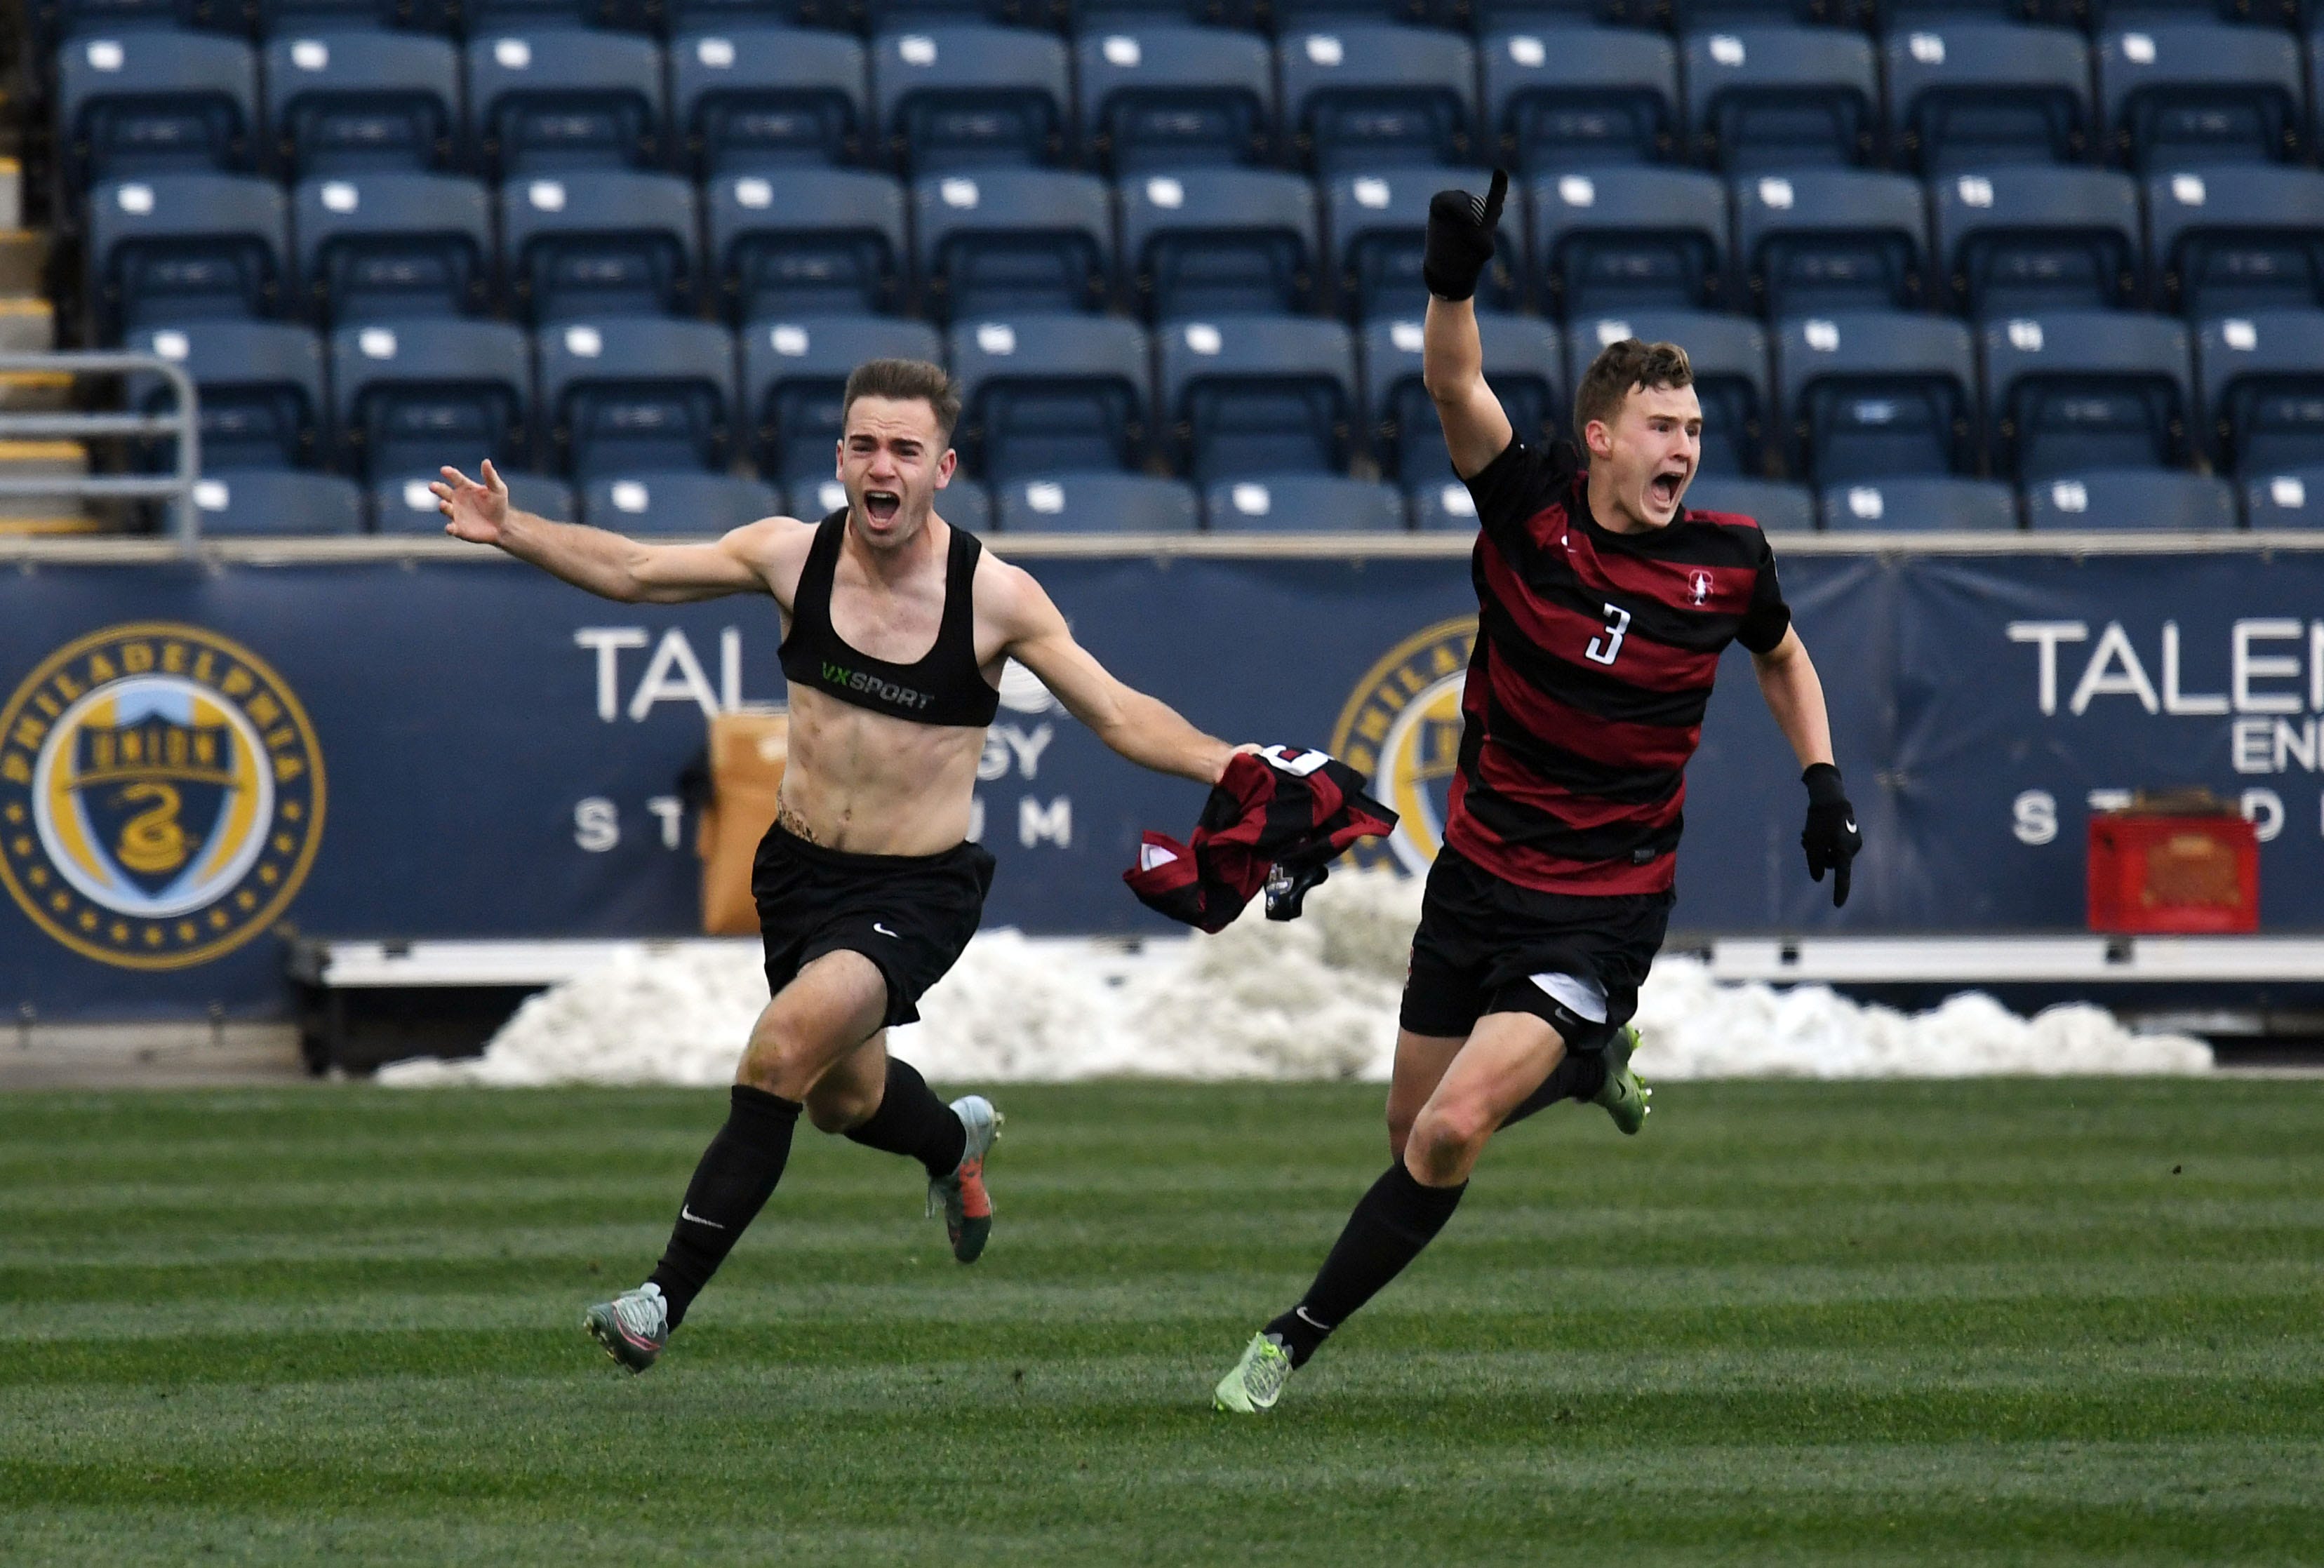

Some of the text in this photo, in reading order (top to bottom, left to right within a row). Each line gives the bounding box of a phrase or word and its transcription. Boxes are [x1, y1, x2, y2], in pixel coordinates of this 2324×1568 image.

[1584, 602, 1631, 666] 3
[822, 661, 935, 710] VXSPORT
[2008, 618, 2324, 716] TALE
[3, 643, 303, 784] PHILADELPHIA
[2232, 713, 2324, 774] EN
